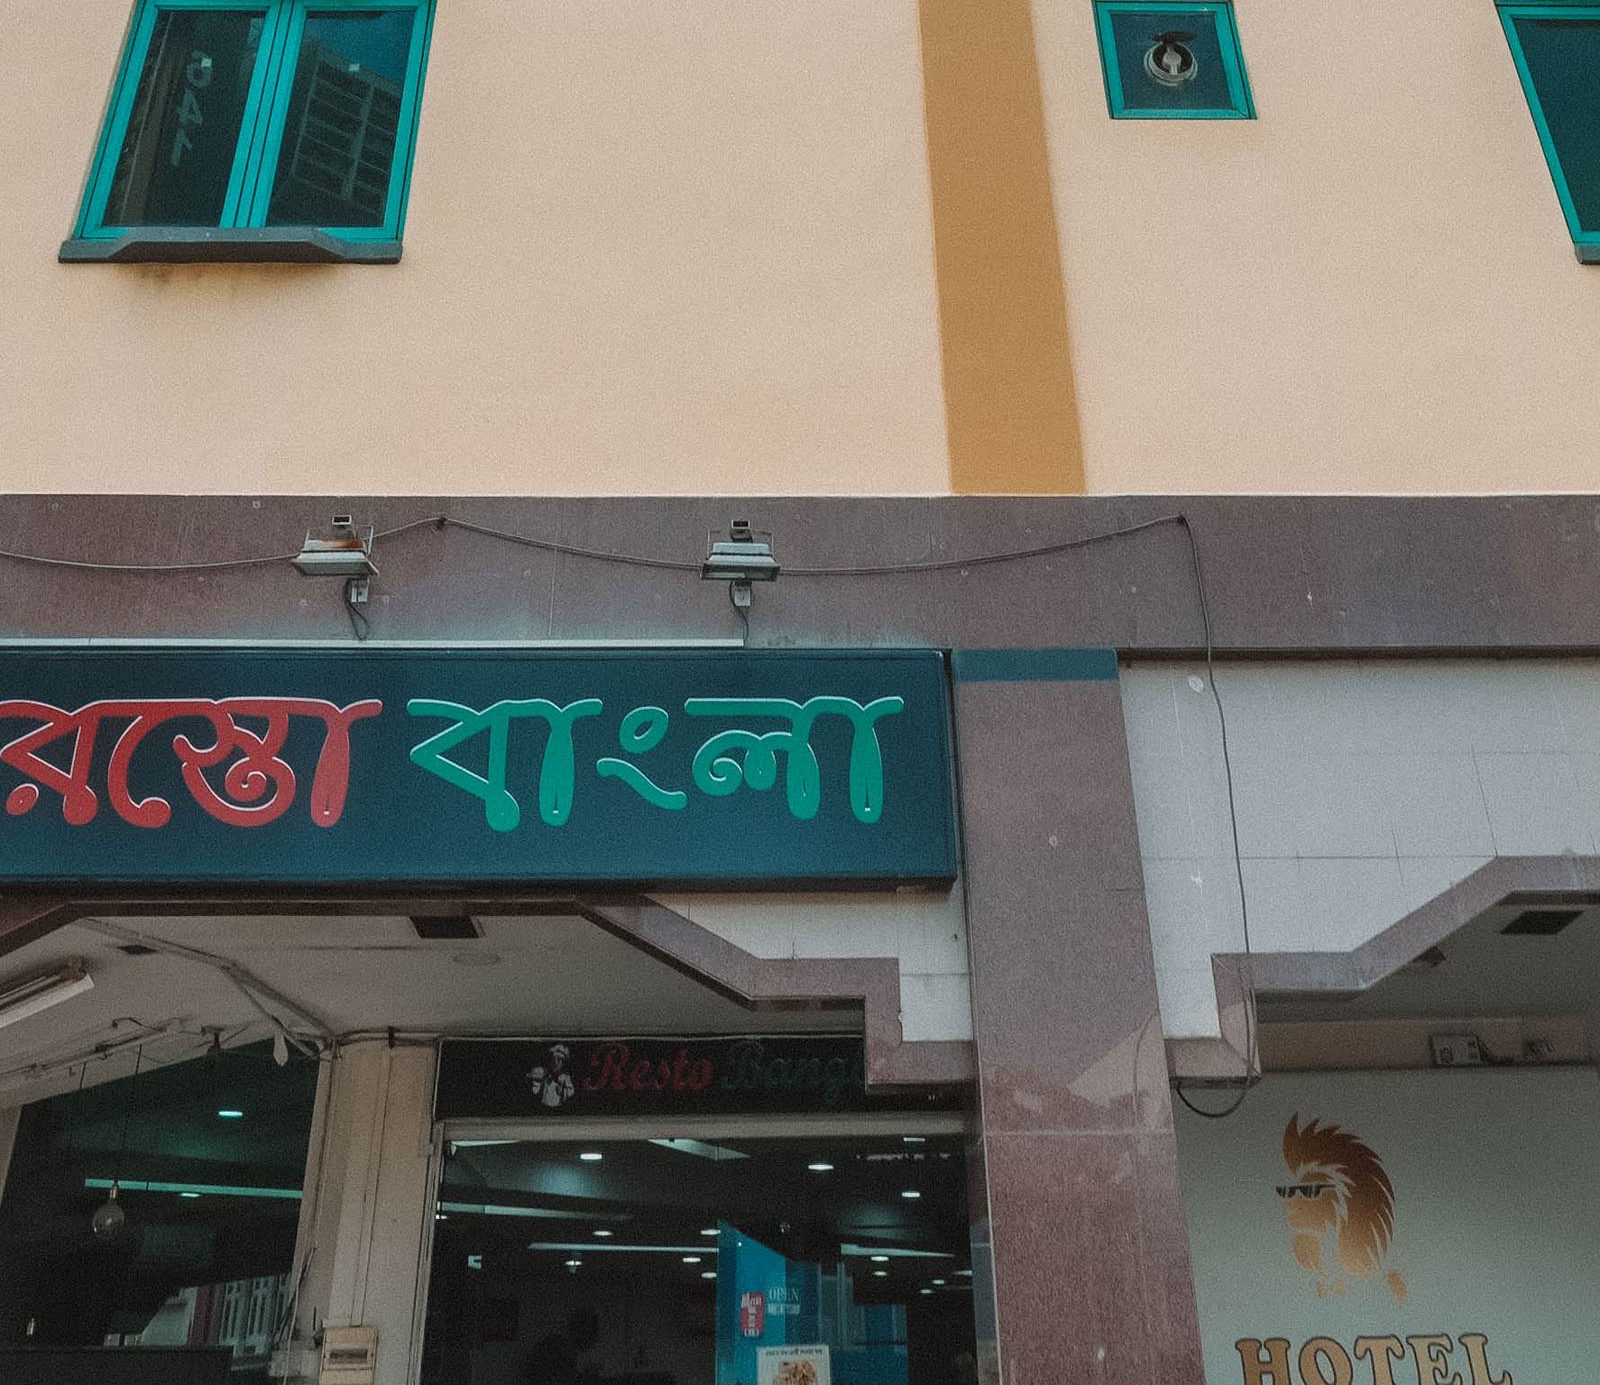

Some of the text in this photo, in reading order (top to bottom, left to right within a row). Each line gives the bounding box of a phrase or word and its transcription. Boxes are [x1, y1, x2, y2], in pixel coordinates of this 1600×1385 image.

[0, 695, 905, 831] রস্তো বাংলা
[580, 1041, 716, 1094] Resto
[1234, 1333, 1513, 1384] HOTEL
